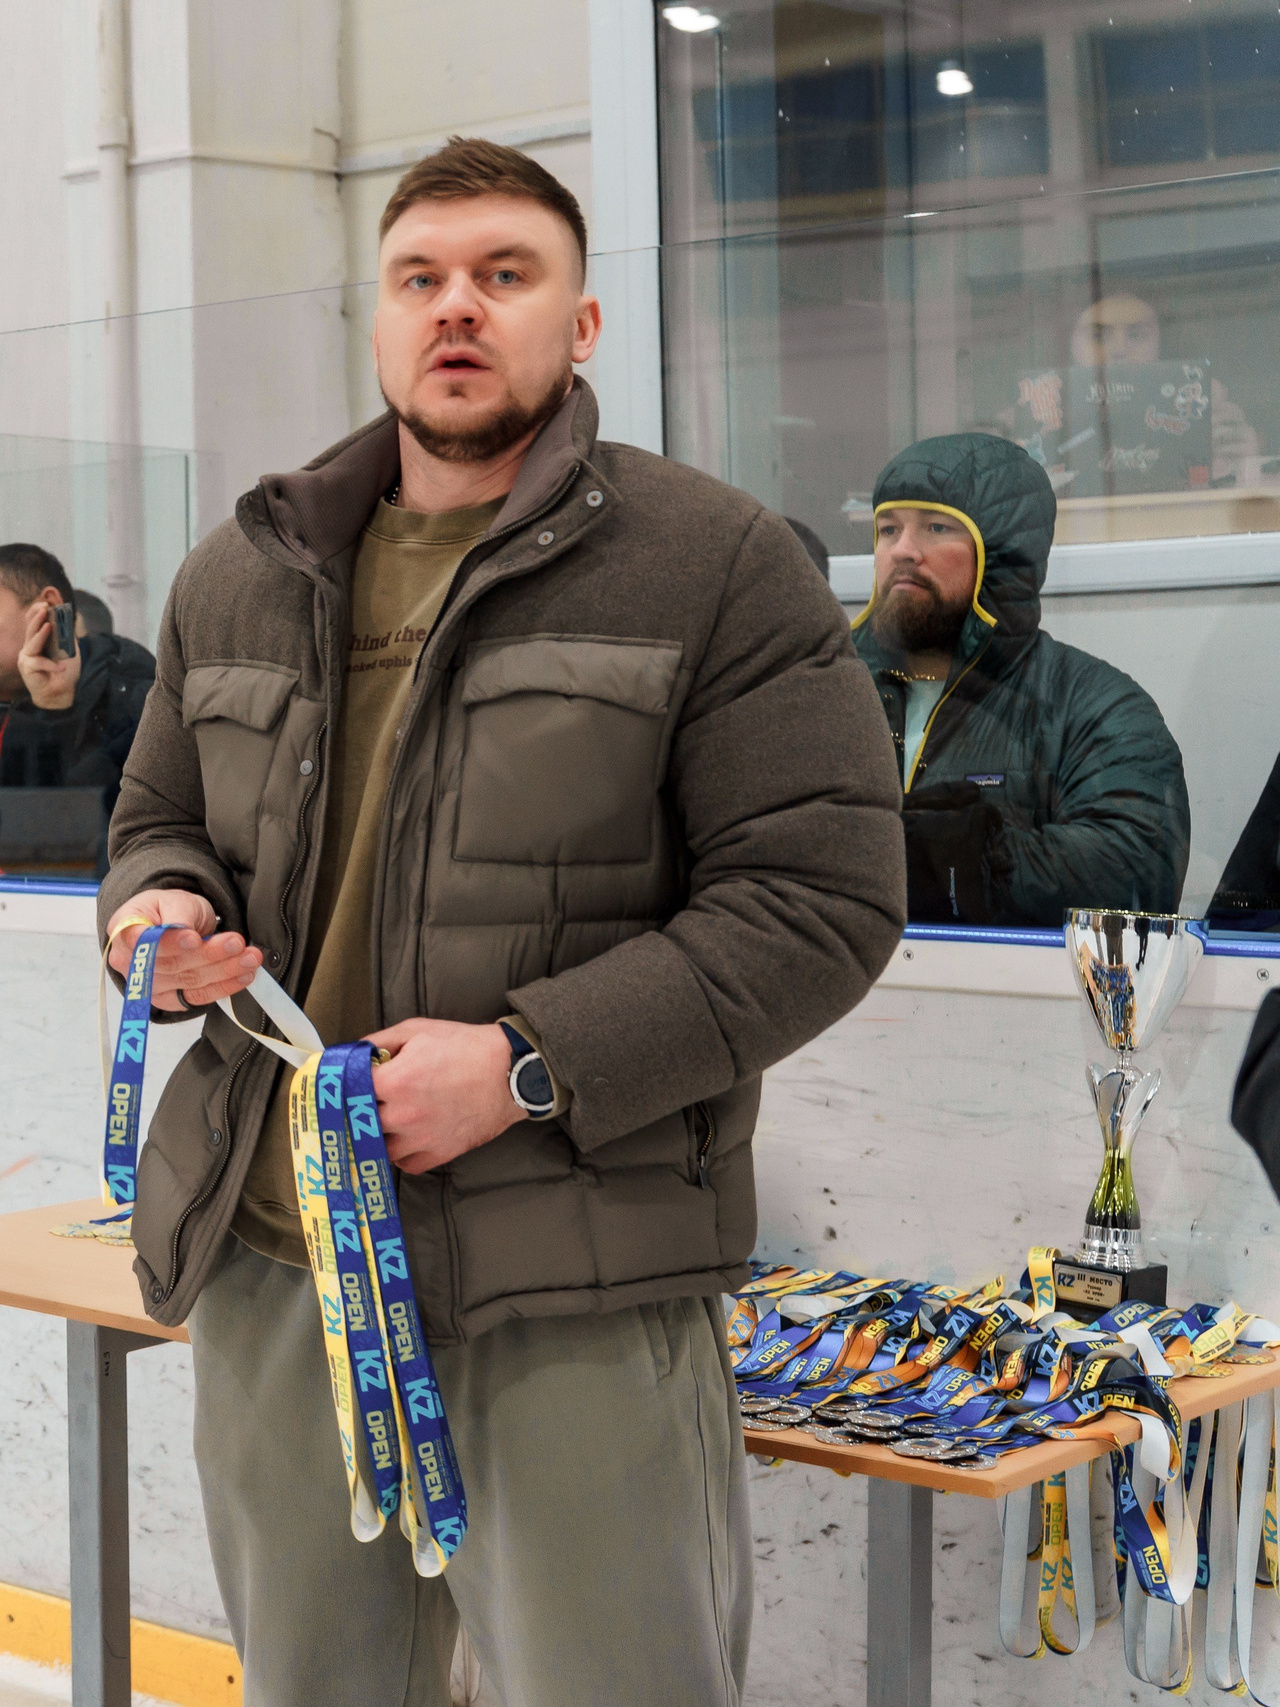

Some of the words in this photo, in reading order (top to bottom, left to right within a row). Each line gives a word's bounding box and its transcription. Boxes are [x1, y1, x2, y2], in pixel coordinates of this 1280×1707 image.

[349, 630, 392, 652] hind
[394, 625, 427, 643] the
[127, 943, 150, 1000] OPEN
[117, 1020, 147, 1063] KZ
[318, 1065, 343, 1110] KZ
[108, 1083, 130, 1146] OPEN
[346, 1094, 380, 1141] KZ
[305, 1154, 325, 1197] KZ
[323, 1130, 342, 1191] OPEN
[108, 1163, 134, 1202] KZ
[359, 1159, 387, 1221] OPEN
[320, 1217, 337, 1275] OPEN
[332, 1210, 361, 1253] KZ
[376, 1237, 408, 1284] KZ
[1077, 1273, 1086, 1282] III
[1034, 1275, 1054, 1308] KZ
[1057, 1272, 1075, 1288] KZ
[322, 1293, 343, 1336] KZ
[342, 1272, 367, 1332] OPEN
[885, 1309, 913, 1327] KZ
[1113, 1302, 1154, 1328] OPEN
[389, 1301, 415, 1364] OPEN
[728, 1312, 755, 1341] KZ
[862, 1318, 890, 1339] OPEN
[943, 1309, 975, 1338] KZ
[969, 1313, 1004, 1351] OPEN
[1193, 1326, 1228, 1354] OPEN
[758, 1339, 792, 1364] OPEN
[806, 1357, 832, 1381] OPEN
[916, 1335, 949, 1366] OPEN
[1036, 1343, 1060, 1376] KZ
[337, 1355, 350, 1414] OPEN
[354, 1349, 387, 1392] KZ
[872, 1373, 904, 1390] KZ
[405, 1377, 436, 1424] KZ
[915, 1389, 949, 1410] KZ
[1073, 1390, 1103, 1415] KZ
[1033, 1414, 1054, 1427] EN
[341, 1430, 354, 1473] KZ
[366, 1410, 392, 1470] OPEN
[417, 1441, 446, 1503] OPEN
[1047, 1470, 1066, 1487] K
[1120, 1476, 1137, 1514] KZ
[1051, 1502, 1064, 1546] OPEN
[1265, 1509, 1278, 1544] KZ
[1041, 1561, 1059, 1592] KZ
[1142, 1545, 1166, 1585] OPEN
